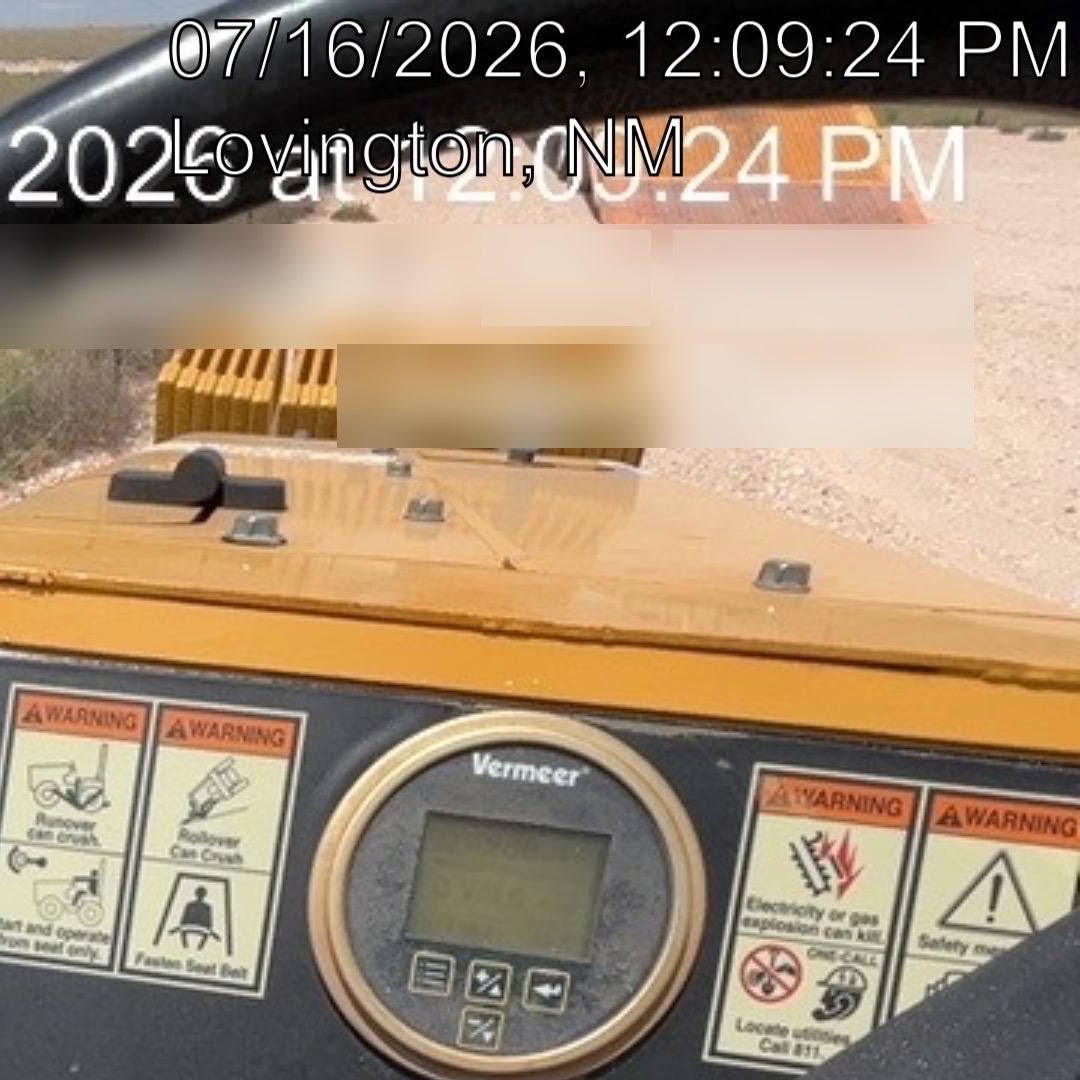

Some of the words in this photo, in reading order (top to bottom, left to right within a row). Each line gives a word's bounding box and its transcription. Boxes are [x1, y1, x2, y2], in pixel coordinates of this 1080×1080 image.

[46, 705, 138, 732] WARNING
[190, 718, 287, 749] WARNING
[472, 752, 581, 787] Vermeer
[793, 785, 904, 818] WARNING
[36, 812, 96, 831] Runover
[965, 806, 1079, 838] WARNING
[27, 828, 54, 841] can
[177, 828, 241, 849] Rollover
[170, 844, 198, 860] Can
[201, 849, 245, 865] Crush
[746, 896, 825, 921] Electricity
[827, 908, 847, 922] or
[848, 911, 880, 928] gas
[25, 922, 53, 937] and
[56, 926, 111, 945] operate
[742, 916, 820, 936] explosion
[823, 927, 853, 940] can
[34, 941, 65, 955] seat
[918, 933, 969, 958] Safety
[135, 951, 182, 970] Fasten
[185, 958, 218, 976] Seat
[220, 963, 248, 981] Belt
[735, 1016, 789, 1038] Locate
[759, 1037, 791, 1054] Call
